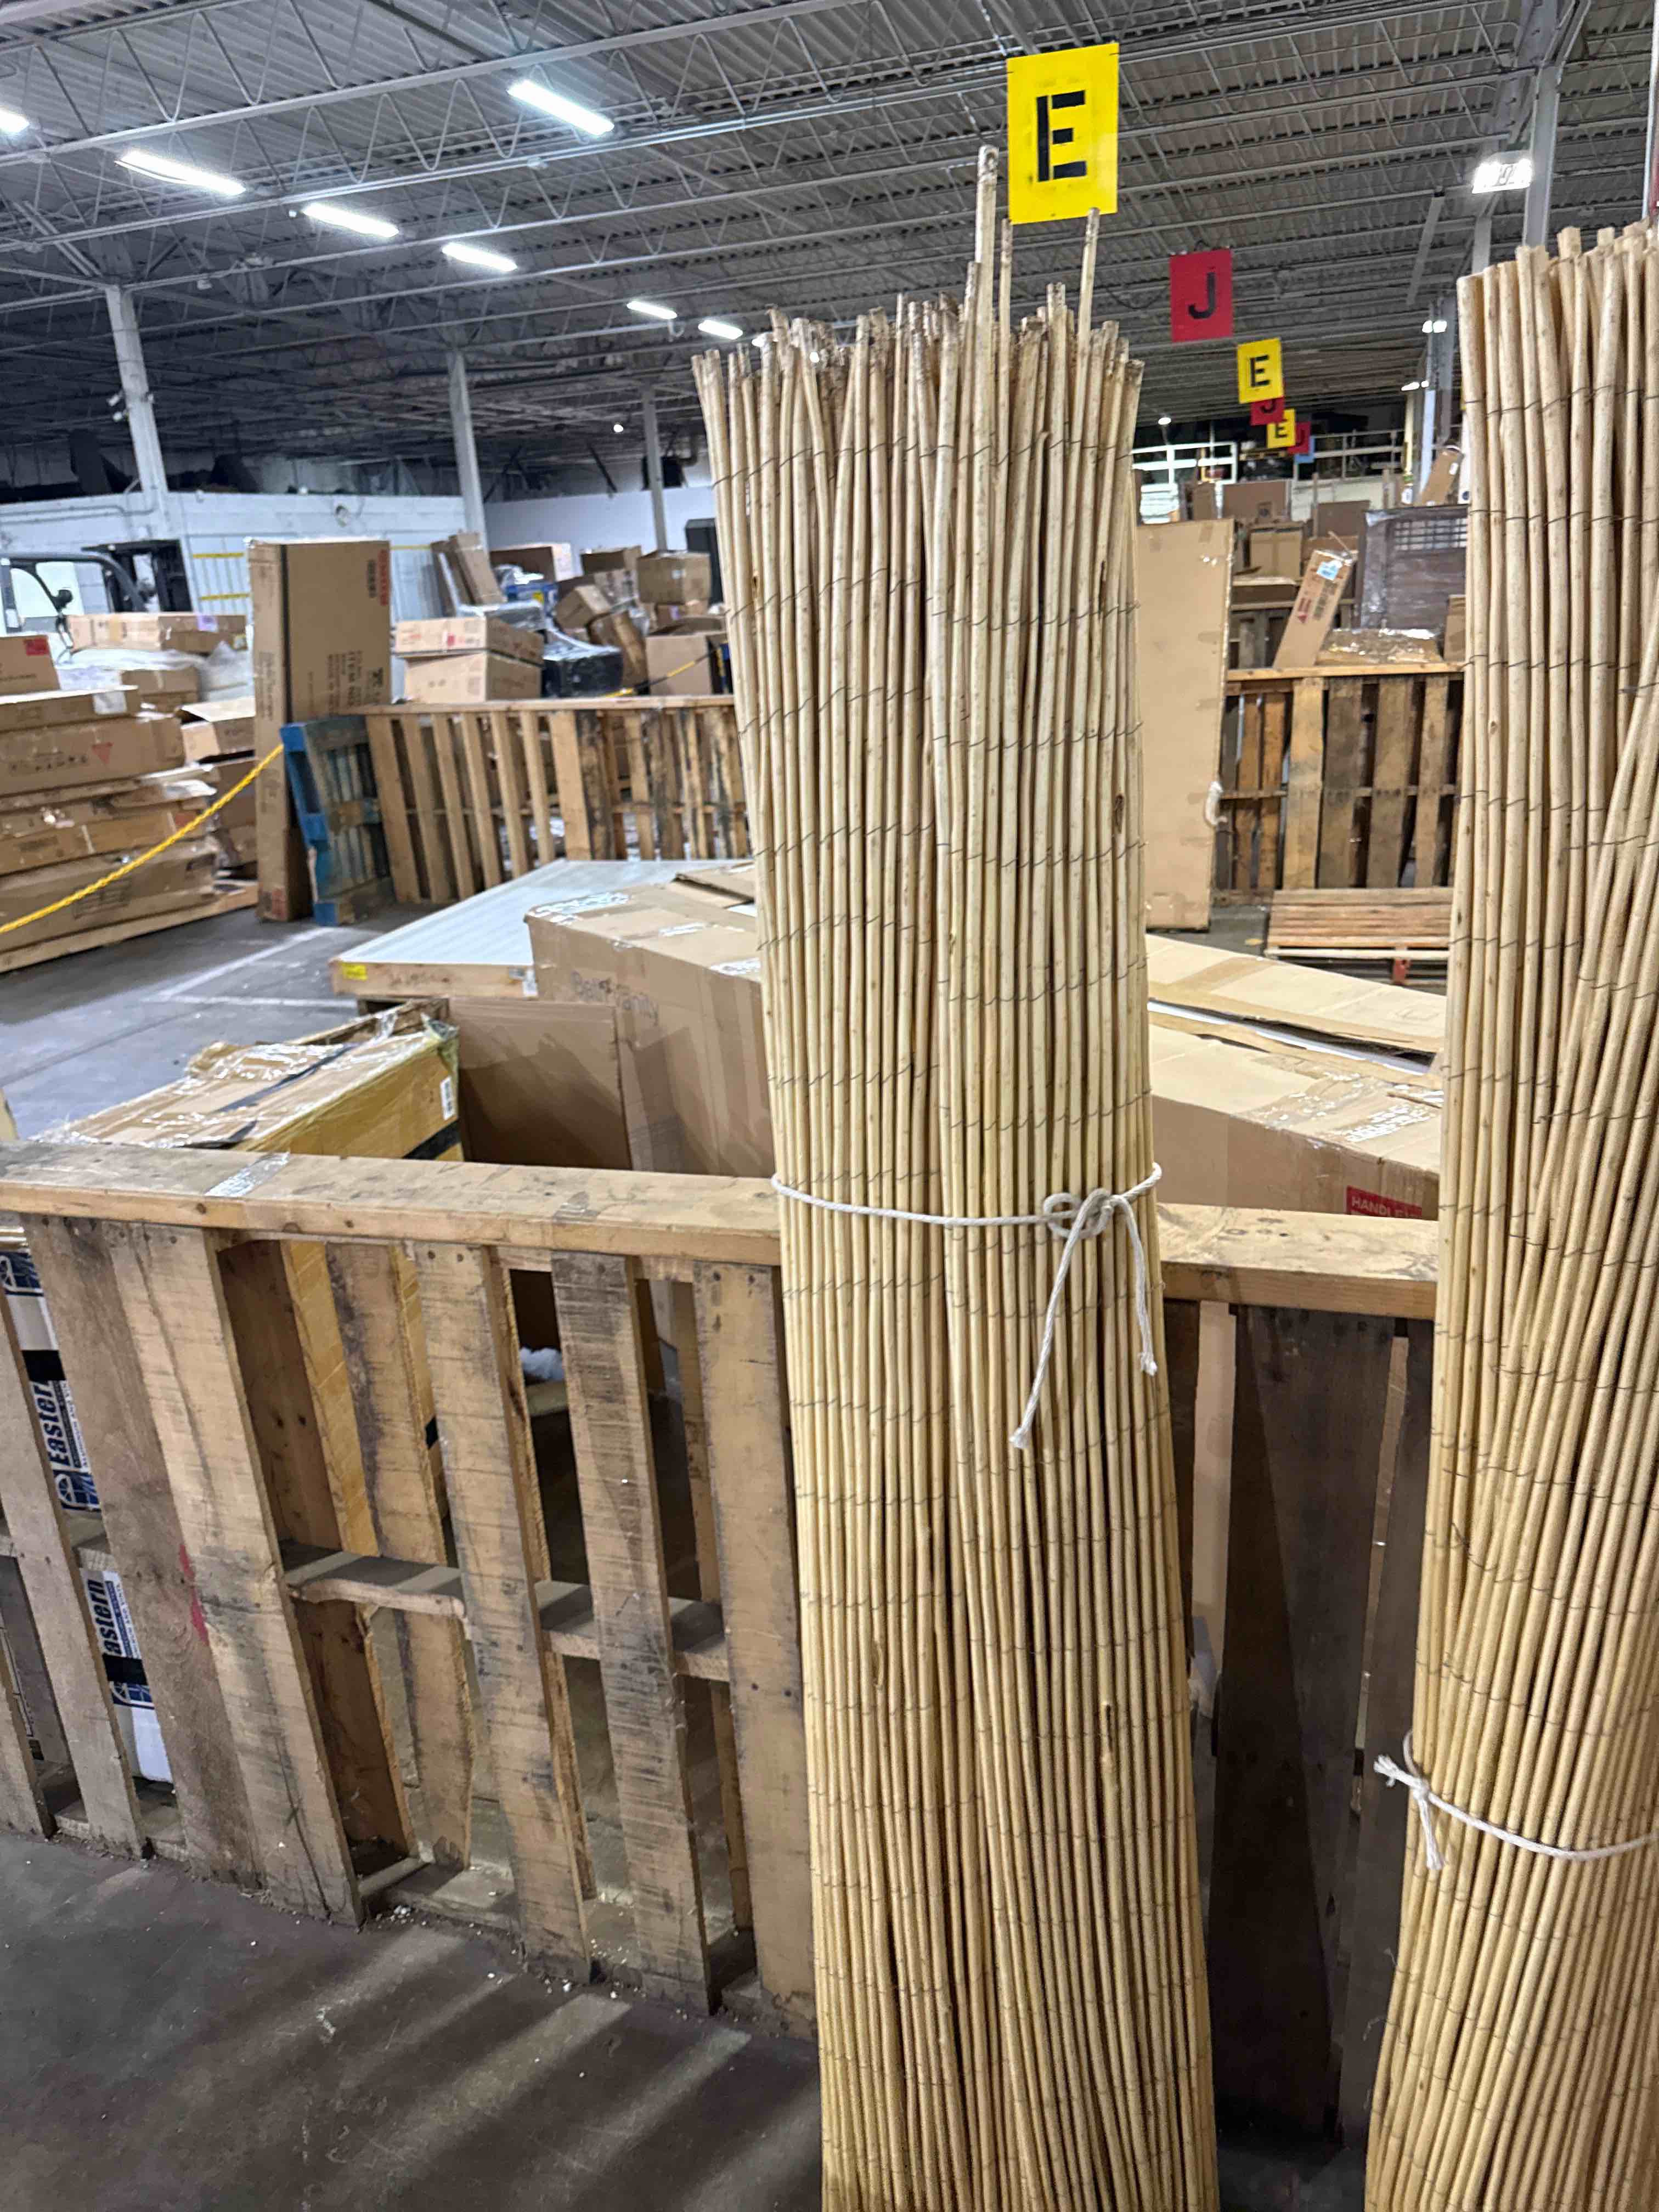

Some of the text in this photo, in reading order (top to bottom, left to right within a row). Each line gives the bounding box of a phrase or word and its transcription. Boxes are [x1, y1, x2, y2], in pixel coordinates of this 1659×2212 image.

[1036, 89, 1087, 182] E
[1188, 272, 1216, 319] J
[1250, 354, 1271, 387] E
[1274, 424, 1288, 439] E
[33, 1381, 71, 1466] Easter
[87, 1579, 122, 1655] astern
